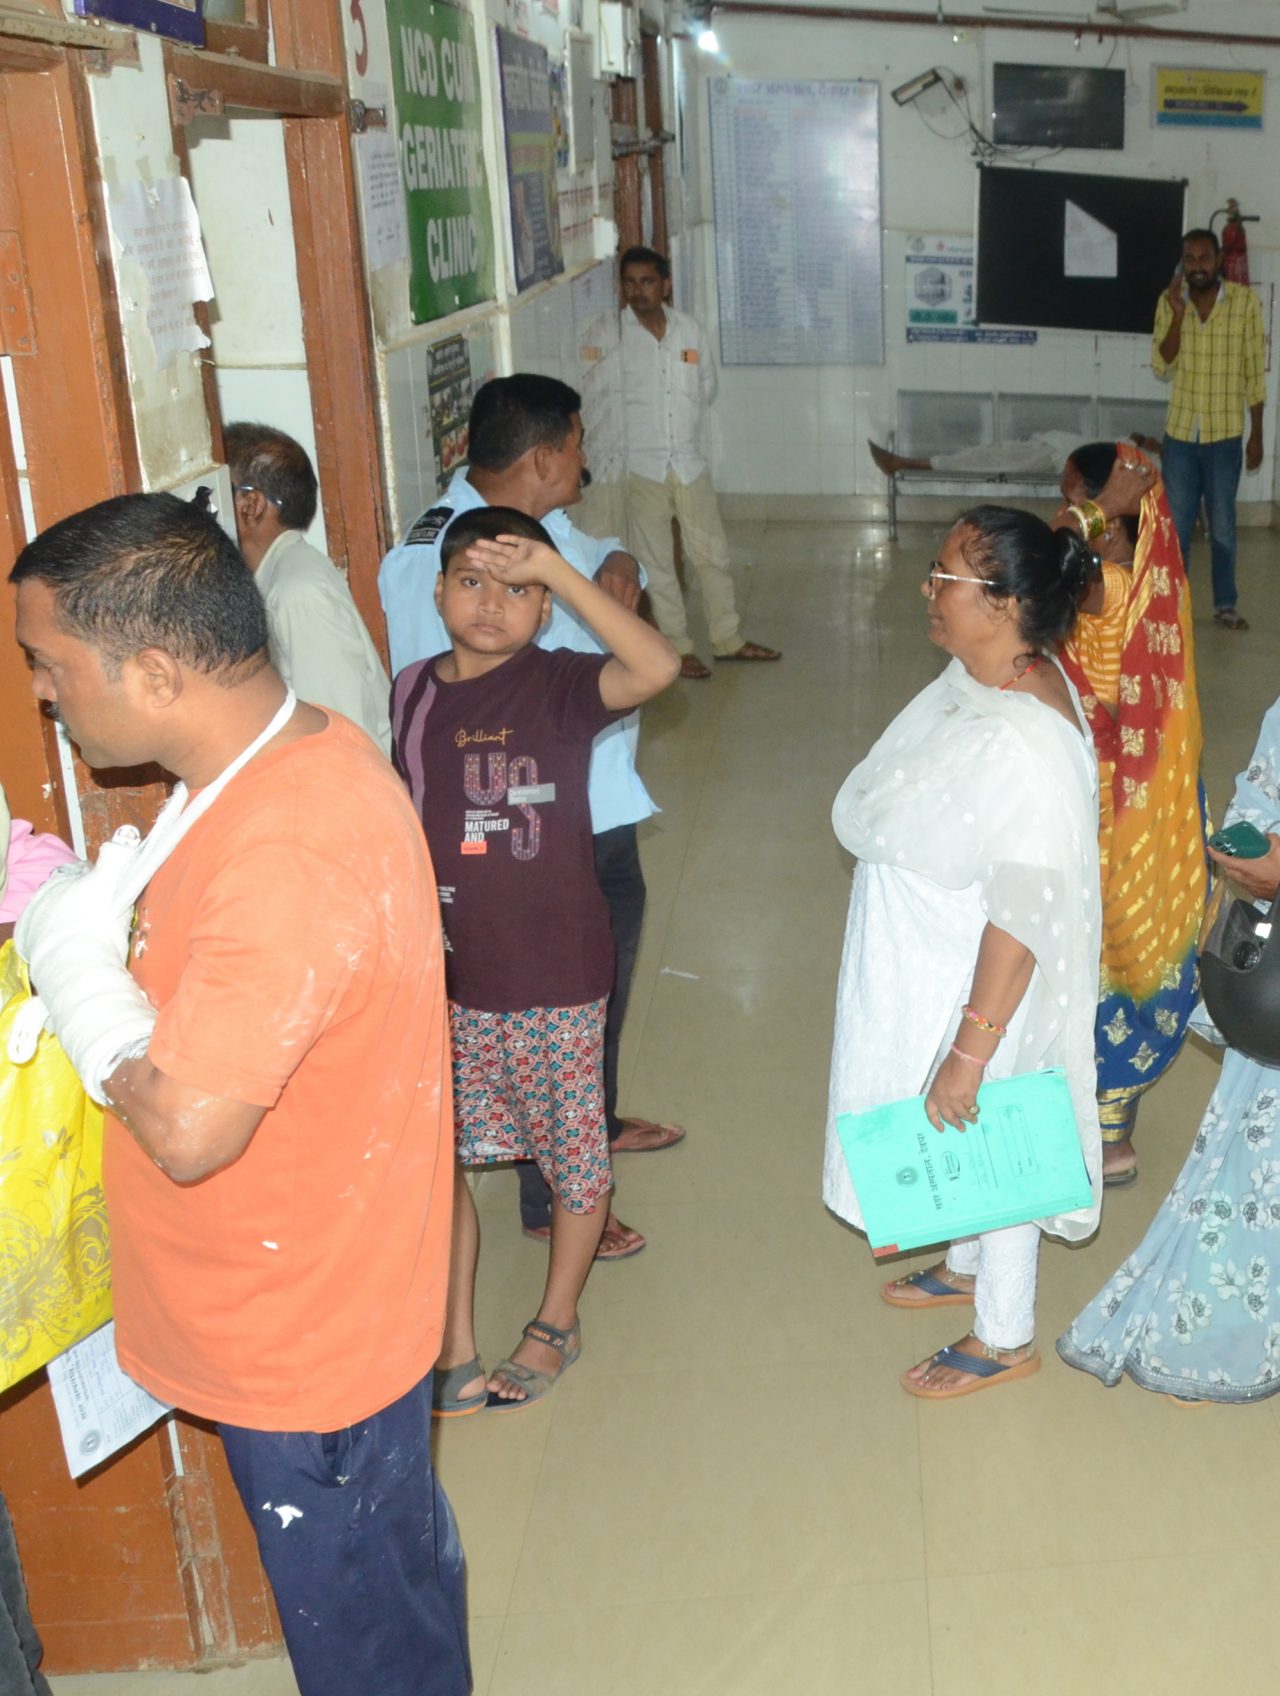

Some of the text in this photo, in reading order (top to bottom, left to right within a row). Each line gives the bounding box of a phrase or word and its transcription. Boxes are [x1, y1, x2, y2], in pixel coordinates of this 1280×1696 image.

[400, 24, 437, 97] NCD
[441, 37, 475, 103] CUM
[401, 122, 483, 192] GERIATRIC
[426, 215, 479, 284] CLINIC
[454, 728, 514, 747] Brilliant
[464, 832, 485, 843] AND
[465, 818, 510, 832] MATURED
